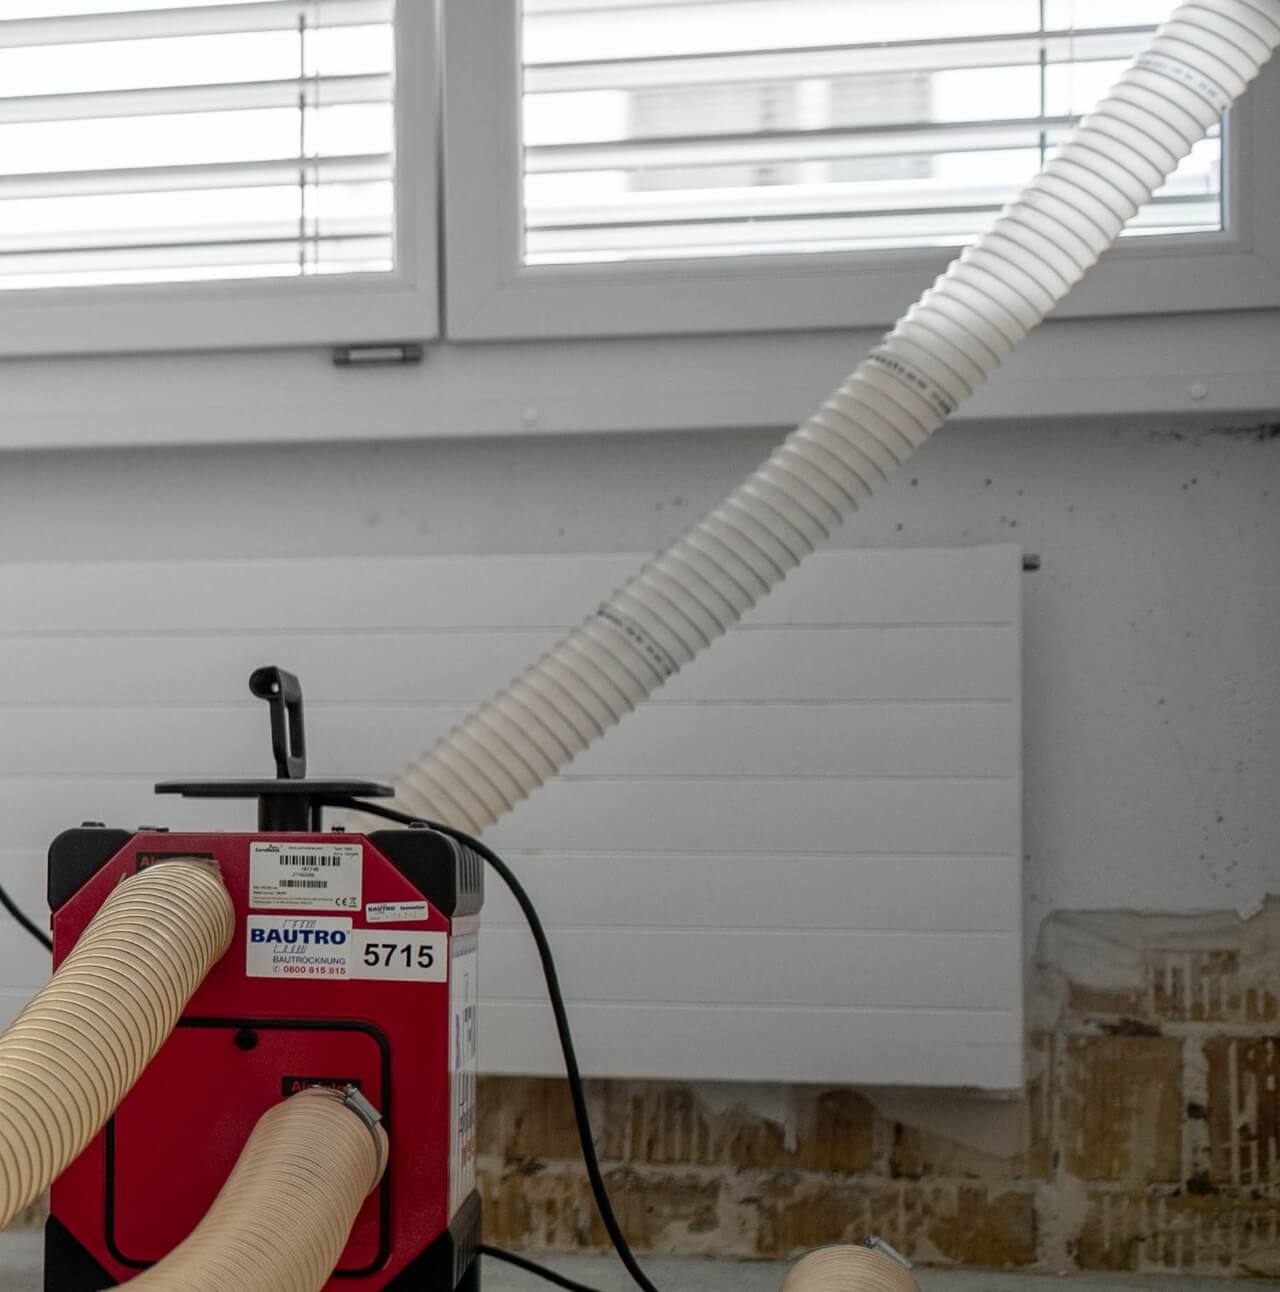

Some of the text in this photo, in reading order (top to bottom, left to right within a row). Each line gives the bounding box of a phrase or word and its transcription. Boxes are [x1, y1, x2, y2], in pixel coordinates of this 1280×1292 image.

[250, 928, 346, 945] BAUTRO
[272, 955, 346, 965] BAUTROCKNUNG
[363, 943, 434, 968] 5715
[283, 965, 346, 975] 0800 815 815
